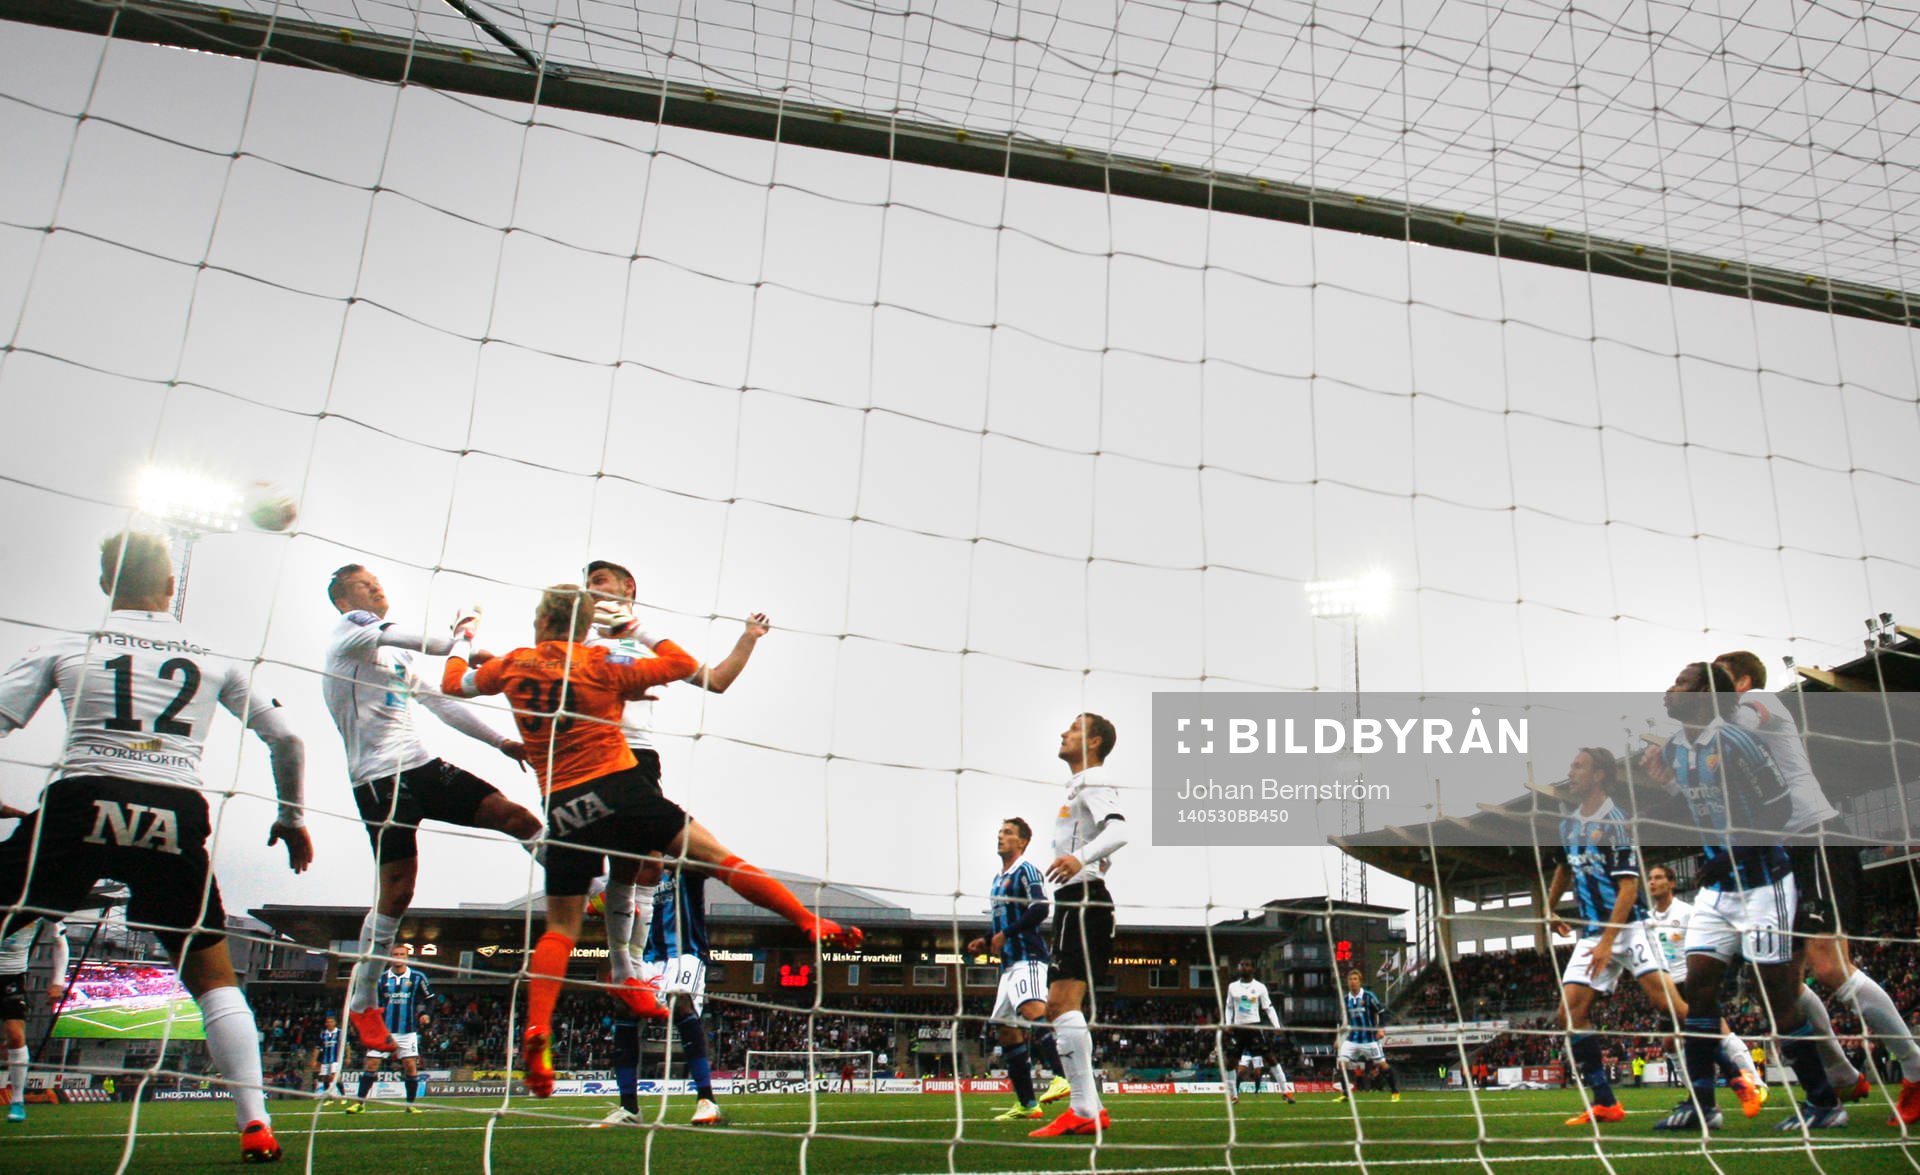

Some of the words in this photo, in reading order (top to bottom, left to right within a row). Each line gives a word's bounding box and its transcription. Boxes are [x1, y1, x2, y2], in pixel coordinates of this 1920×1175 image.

[104, 655, 201, 737] 12
[88, 744, 196, 770] NORRPORTEN
[551, 791, 616, 837] NA
[83, 800, 182, 856] NA
[1755, 925, 1774, 954] 11
[570, 947, 610, 958] tcenter
[1625, 943, 1649, 967] 22
[675, 969, 692, 985] 18
[1015, 979, 1028, 998] 10
[155, 1089, 213, 1099] LINDSTRÖM
[925, 1081, 954, 1091] PUMA
[970, 1081, 999, 1091] PUMA
